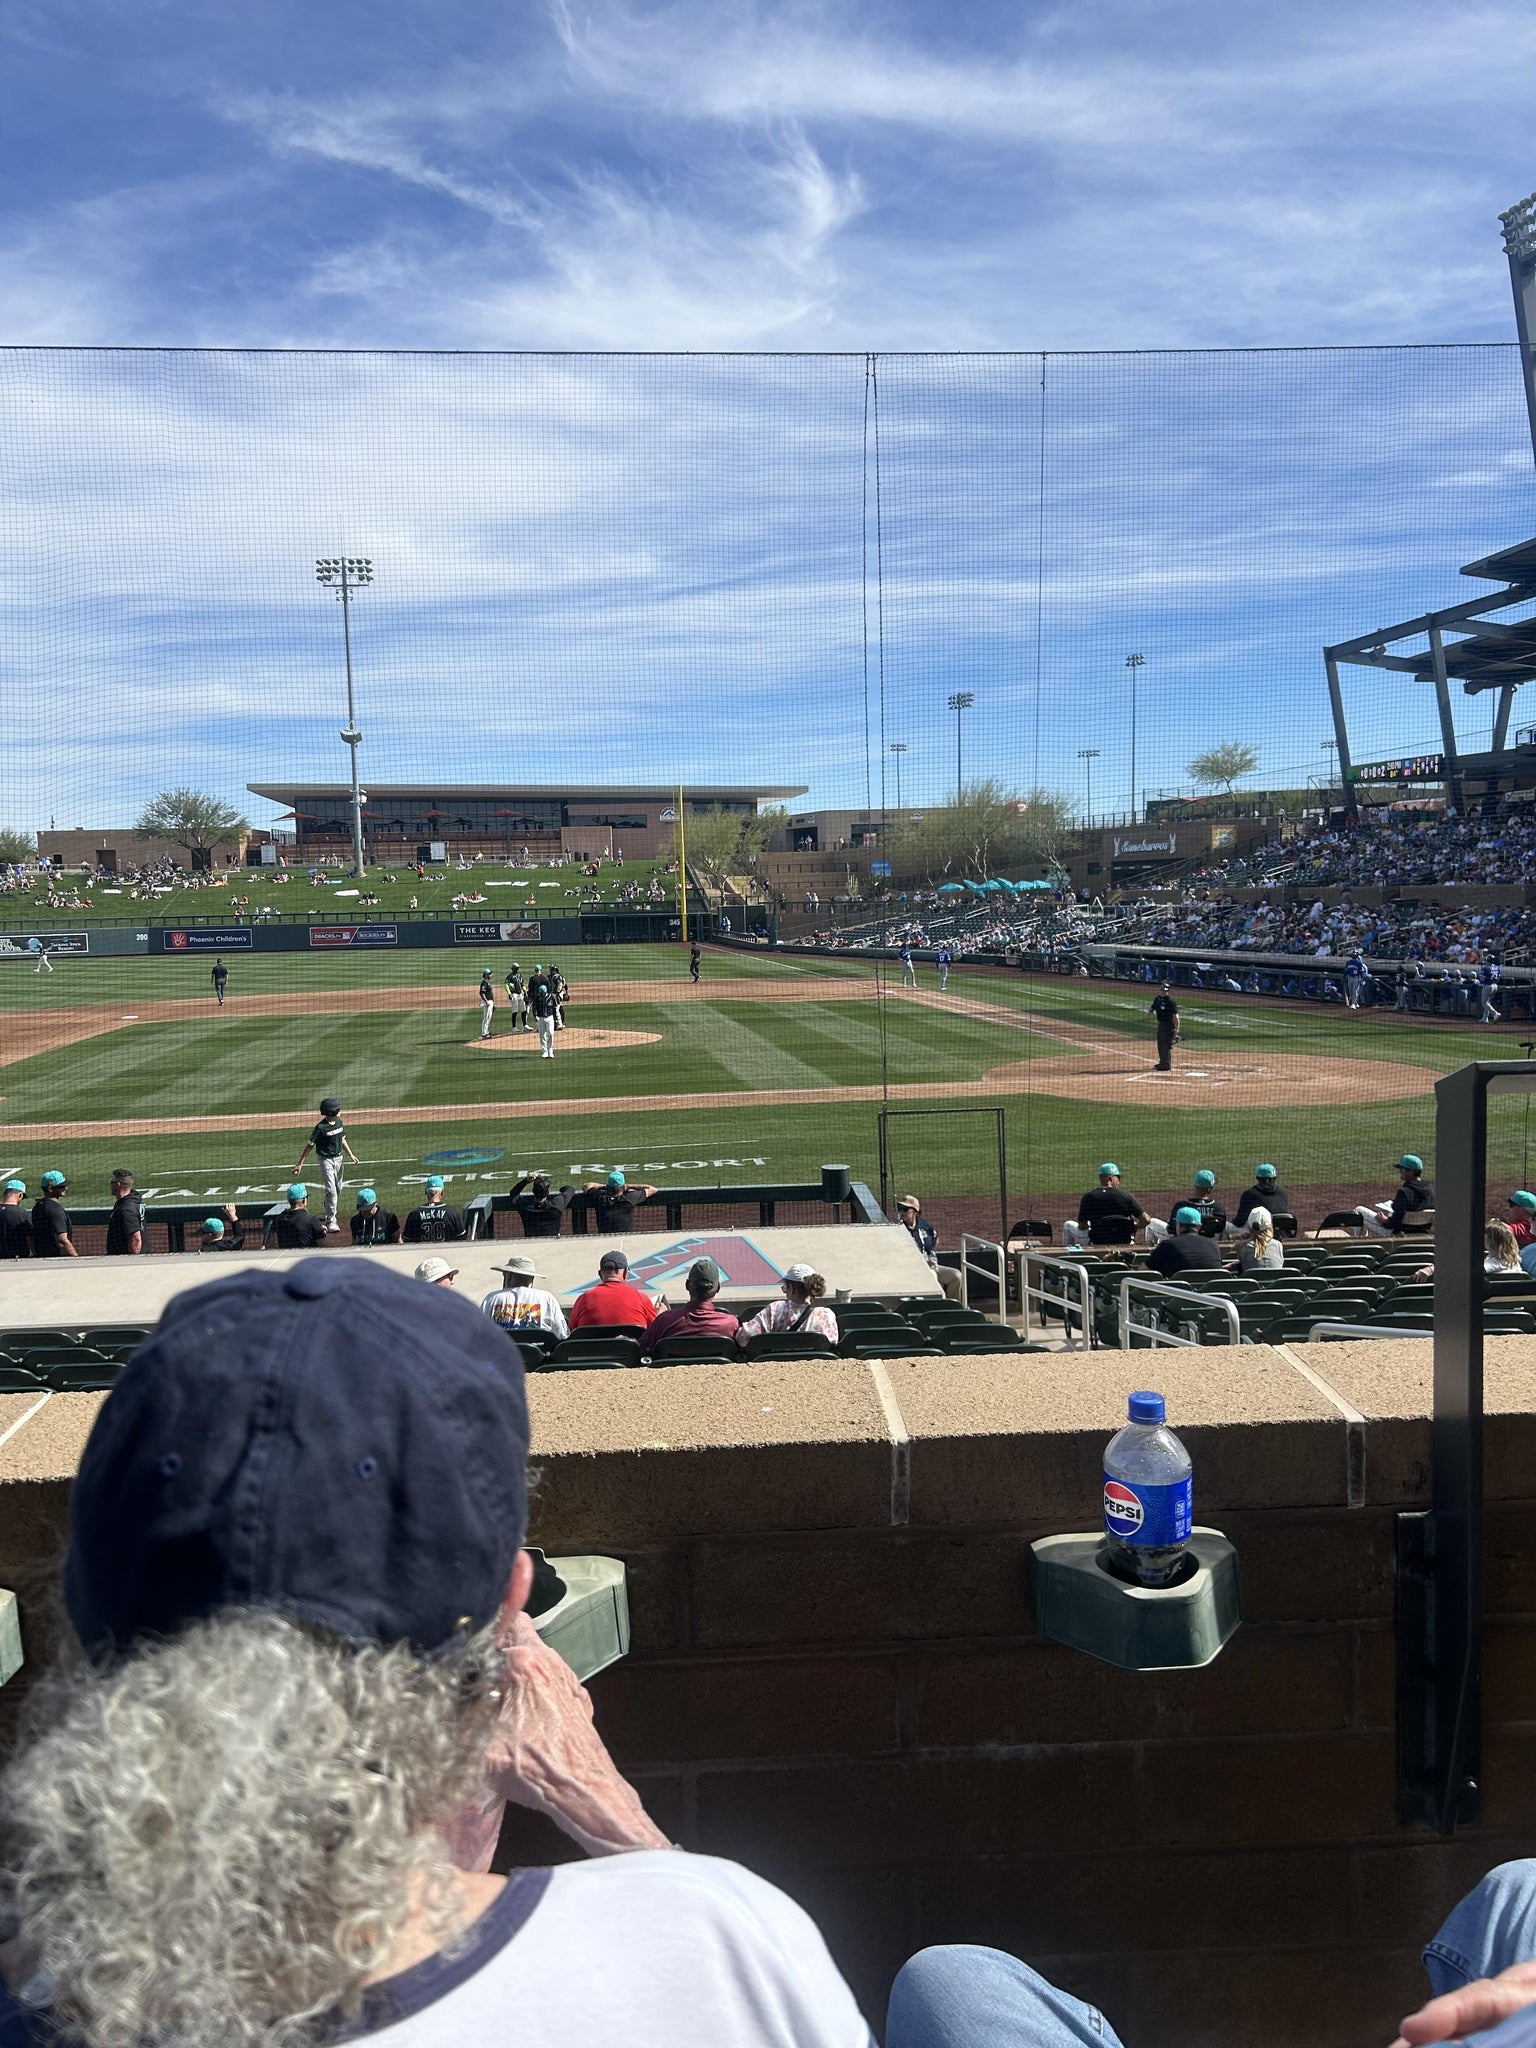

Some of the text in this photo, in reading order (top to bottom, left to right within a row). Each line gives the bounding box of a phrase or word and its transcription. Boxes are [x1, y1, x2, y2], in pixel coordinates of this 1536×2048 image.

[567, 1156, 773, 1175] RESORT
[420, 1221, 446, 1242] 36
[1105, 1494, 1141, 1520] PEPSI
